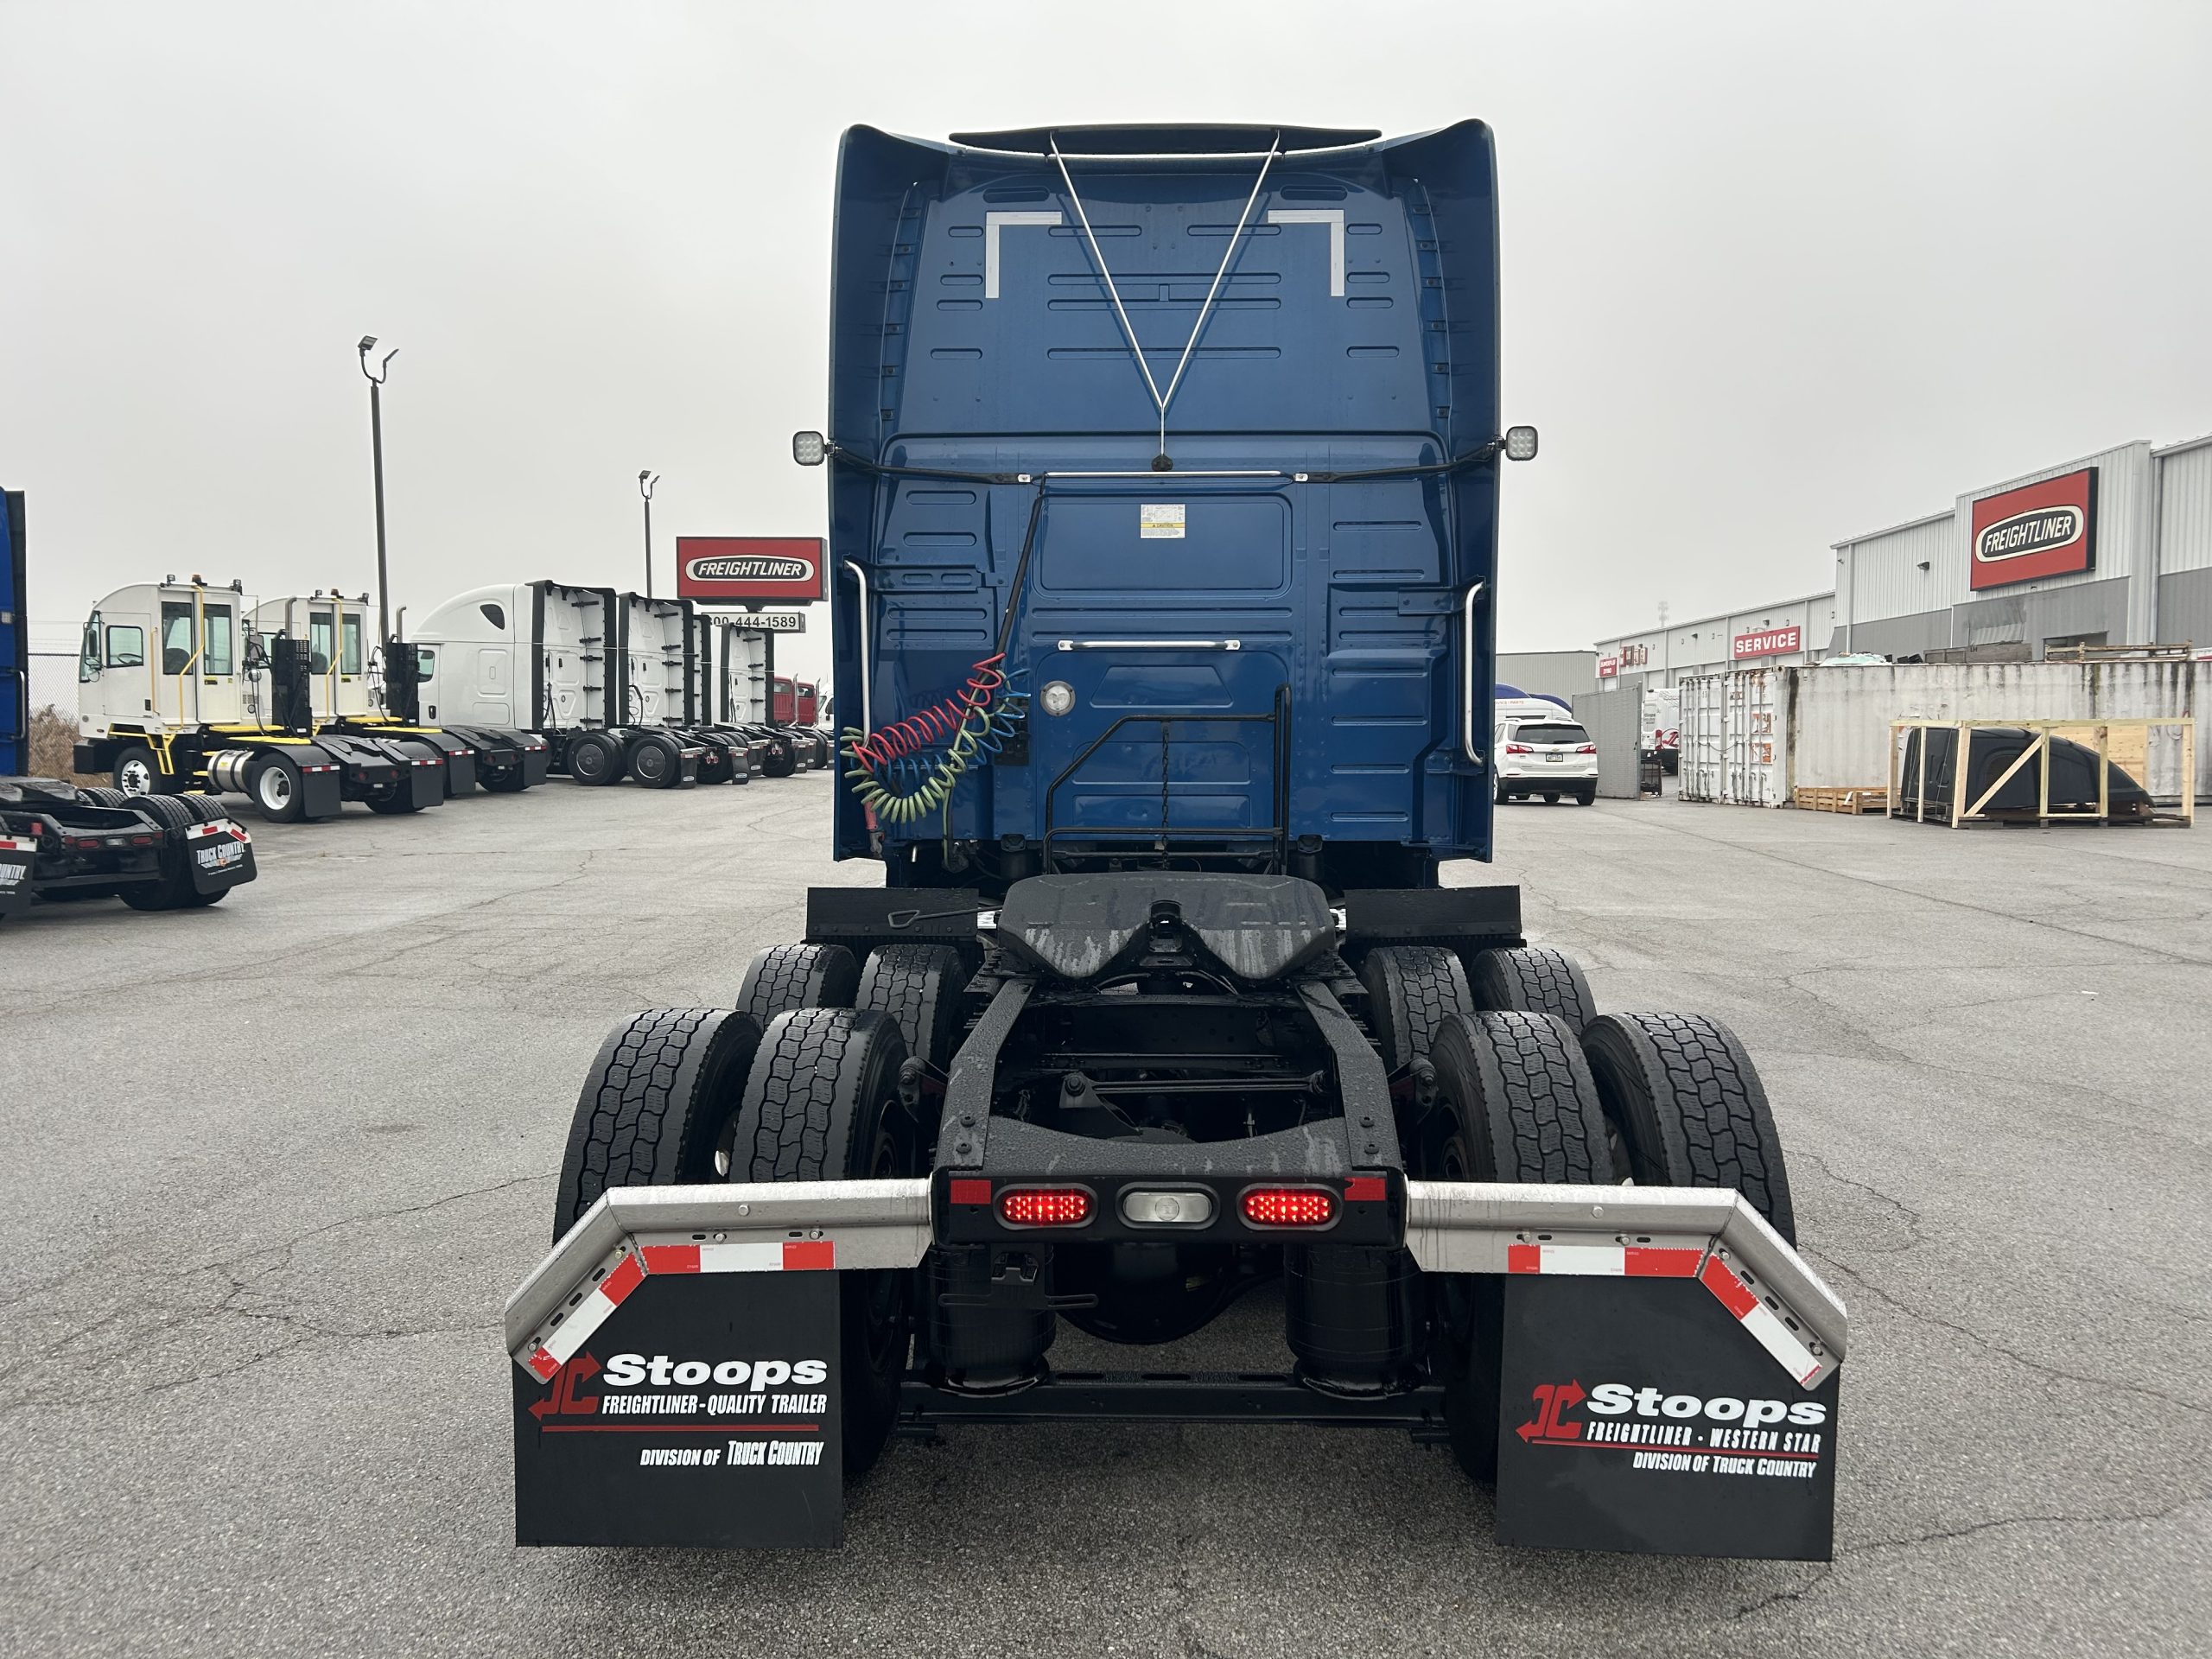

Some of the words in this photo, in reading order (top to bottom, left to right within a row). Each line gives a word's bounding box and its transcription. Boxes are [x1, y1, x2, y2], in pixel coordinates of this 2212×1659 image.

[1984, 515, 2073, 554] FREIGHTLINER
[697, 561, 803, 576] FREIGHTLINER
[1735, 632, 1796, 653] SERVICE
[196, 846, 217, 865] TRUCK
[217, 841, 245, 859] COUNTRY
[602, 1353, 828, 1392] Stoops
[771, 1394, 827, 1414] TRAILER
[1586, 1383, 1827, 1428] Stoops
[1586, 1421, 1693, 1446] FREIGHTLINER
[1709, 1427, 1779, 1451] WESTERN
[1783, 1431, 1821, 1453] STAR
[639, 1449, 702, 1465] DIVISION
[702, 1449, 721, 1465] OF
[727, 1440, 767, 1465] TRUCK
[767, 1440, 824, 1465] COUNTRY
[1632, 1452, 1692, 1469] DIVISION
[1692, 1454, 1710, 1471] OF
[1713, 1455, 1754, 1475] TRUCK
[1757, 1459, 1817, 1478] COUNTRY
